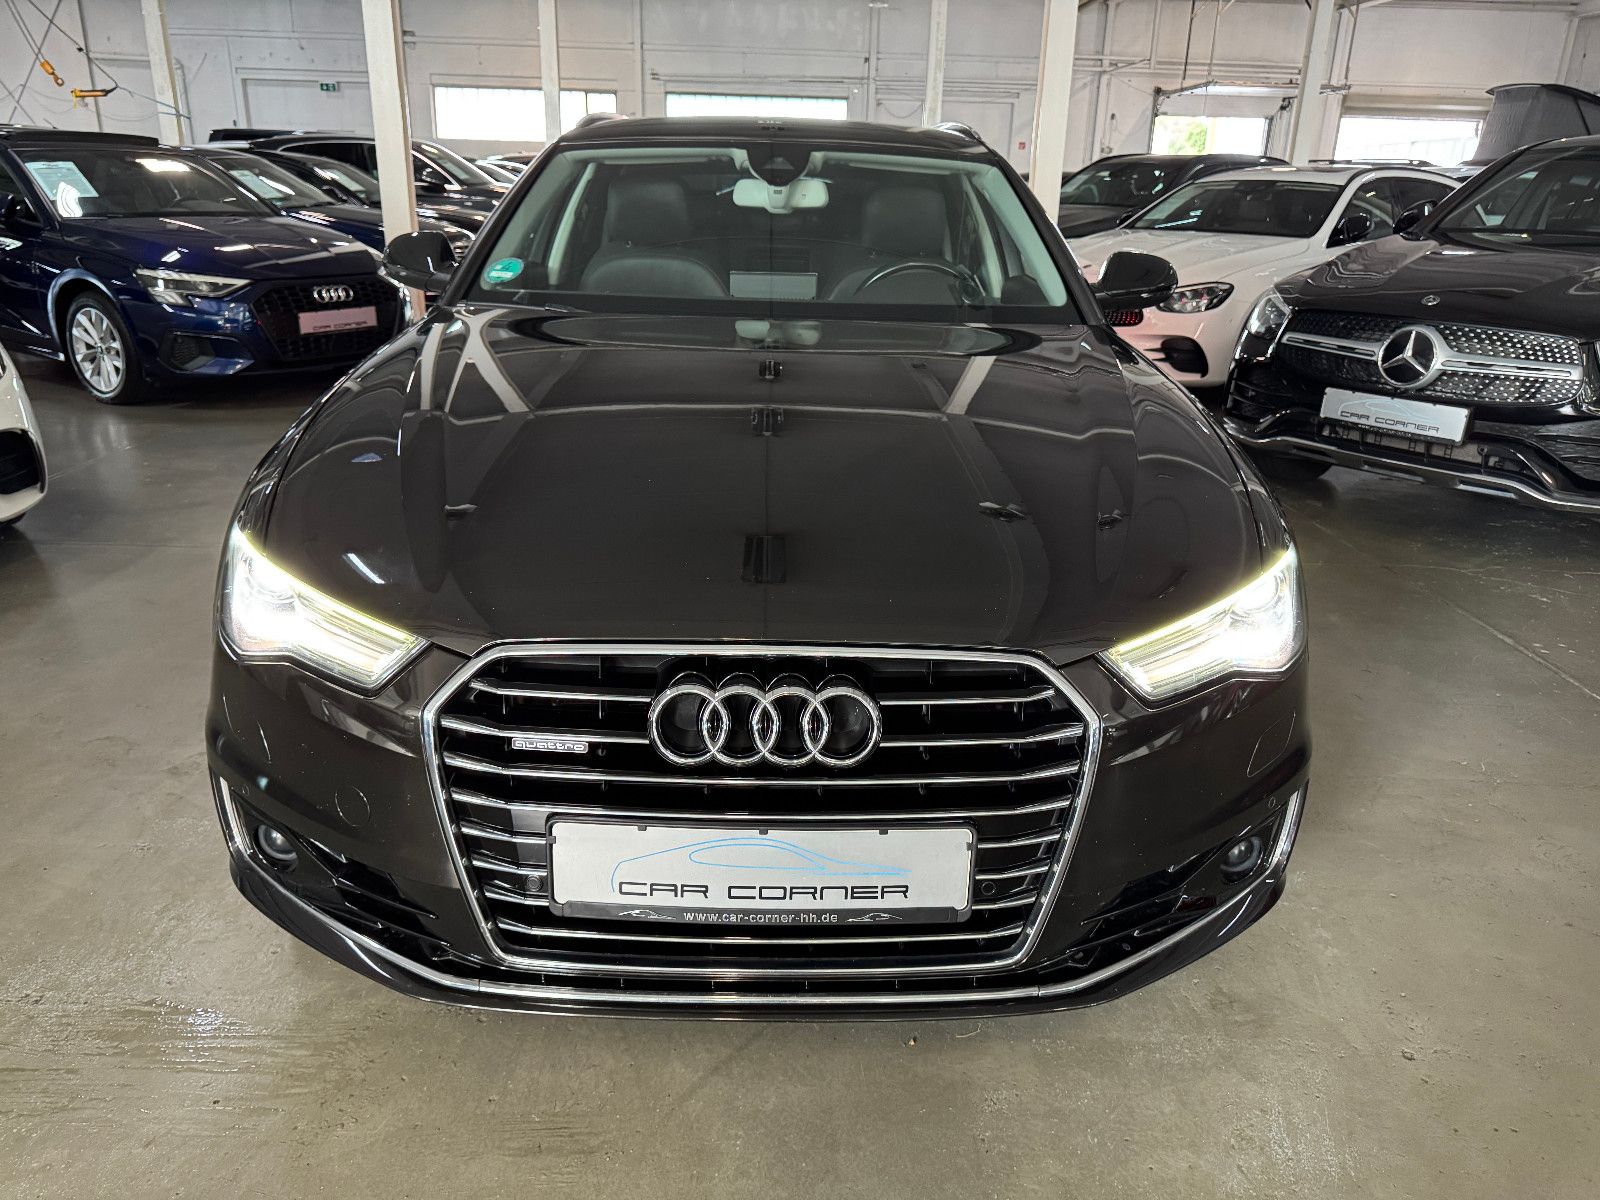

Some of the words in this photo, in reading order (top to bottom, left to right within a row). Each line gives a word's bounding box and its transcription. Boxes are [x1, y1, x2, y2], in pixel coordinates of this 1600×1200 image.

[1340, 411, 1370, 421] CAR
[1374, 417, 1439, 433] CORNER
[514, 740, 585, 751] quattro
[619, 881, 709, 898] CAR
[727, 885, 909, 901] CORNER
[683, 910, 838, 924] www.car-corner-hh.de
